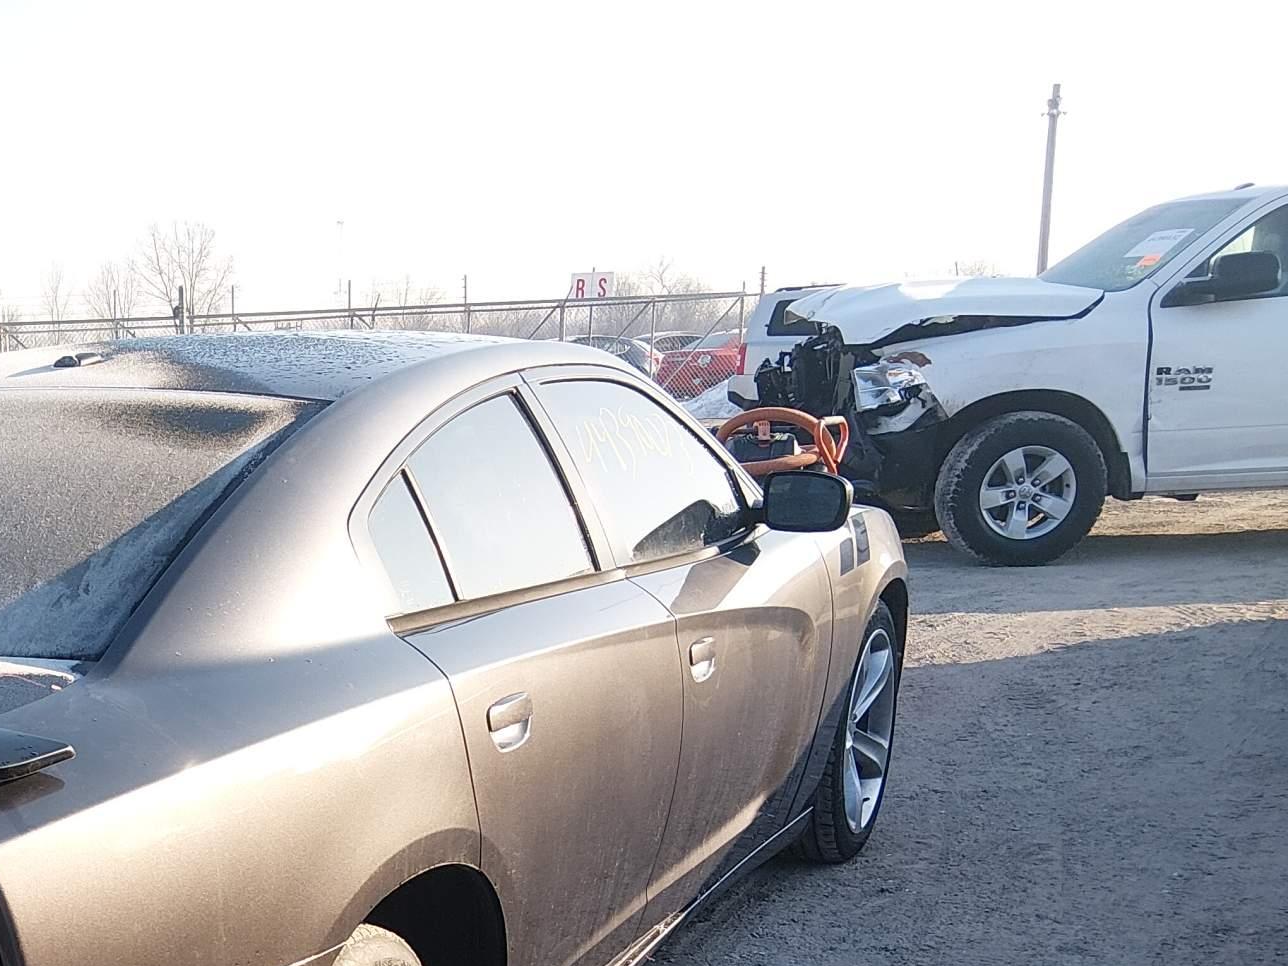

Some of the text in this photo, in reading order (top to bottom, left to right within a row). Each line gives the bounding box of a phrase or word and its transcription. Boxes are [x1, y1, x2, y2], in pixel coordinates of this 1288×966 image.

[597, 277, 608, 297] S
[1156, 366, 1213, 376] RAM
[1155, 375, 1212, 386] 1500
